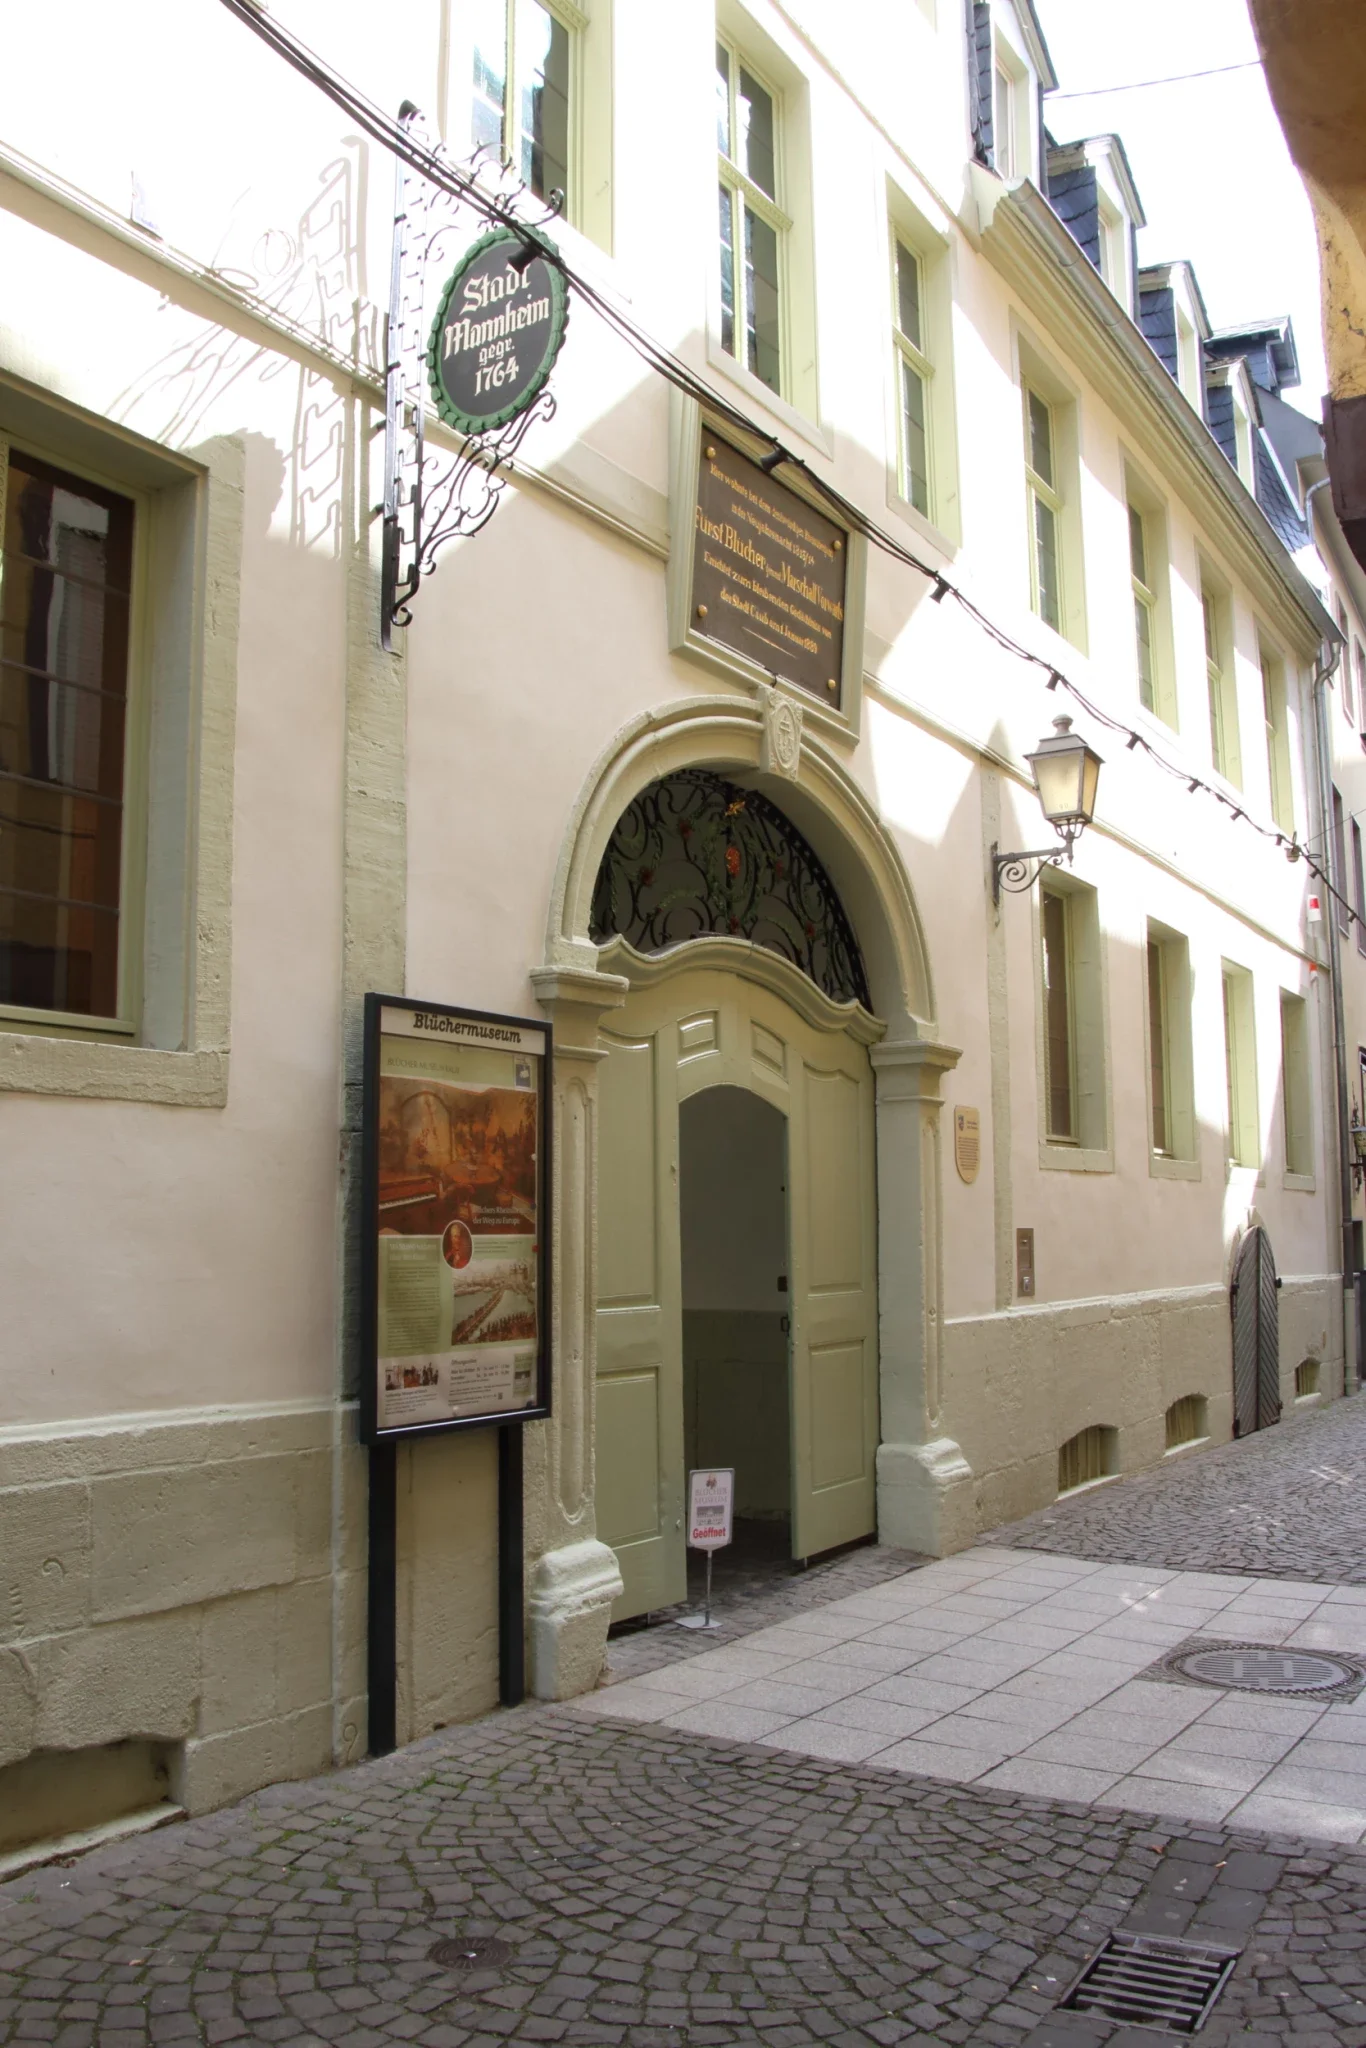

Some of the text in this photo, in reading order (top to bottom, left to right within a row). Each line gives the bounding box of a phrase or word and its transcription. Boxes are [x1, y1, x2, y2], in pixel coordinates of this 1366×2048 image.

[460, 263, 530, 315] Stadt
[444, 294, 549, 361] Mannheim
[478, 337, 515, 367] gegr.
[474, 356, 519, 396] 1764
[724, 524, 766, 571] Blücher
[781, 561, 817, 604] Marschall
[732, 570, 751, 589] zum
[732, 594, 749, 614] Stadt
[413, 1013, 521, 1044] Blüchermuseum
[387, 1057, 417, 1068] BLÜCHER
[693, 1527, 726, 1539] Geöffnet
